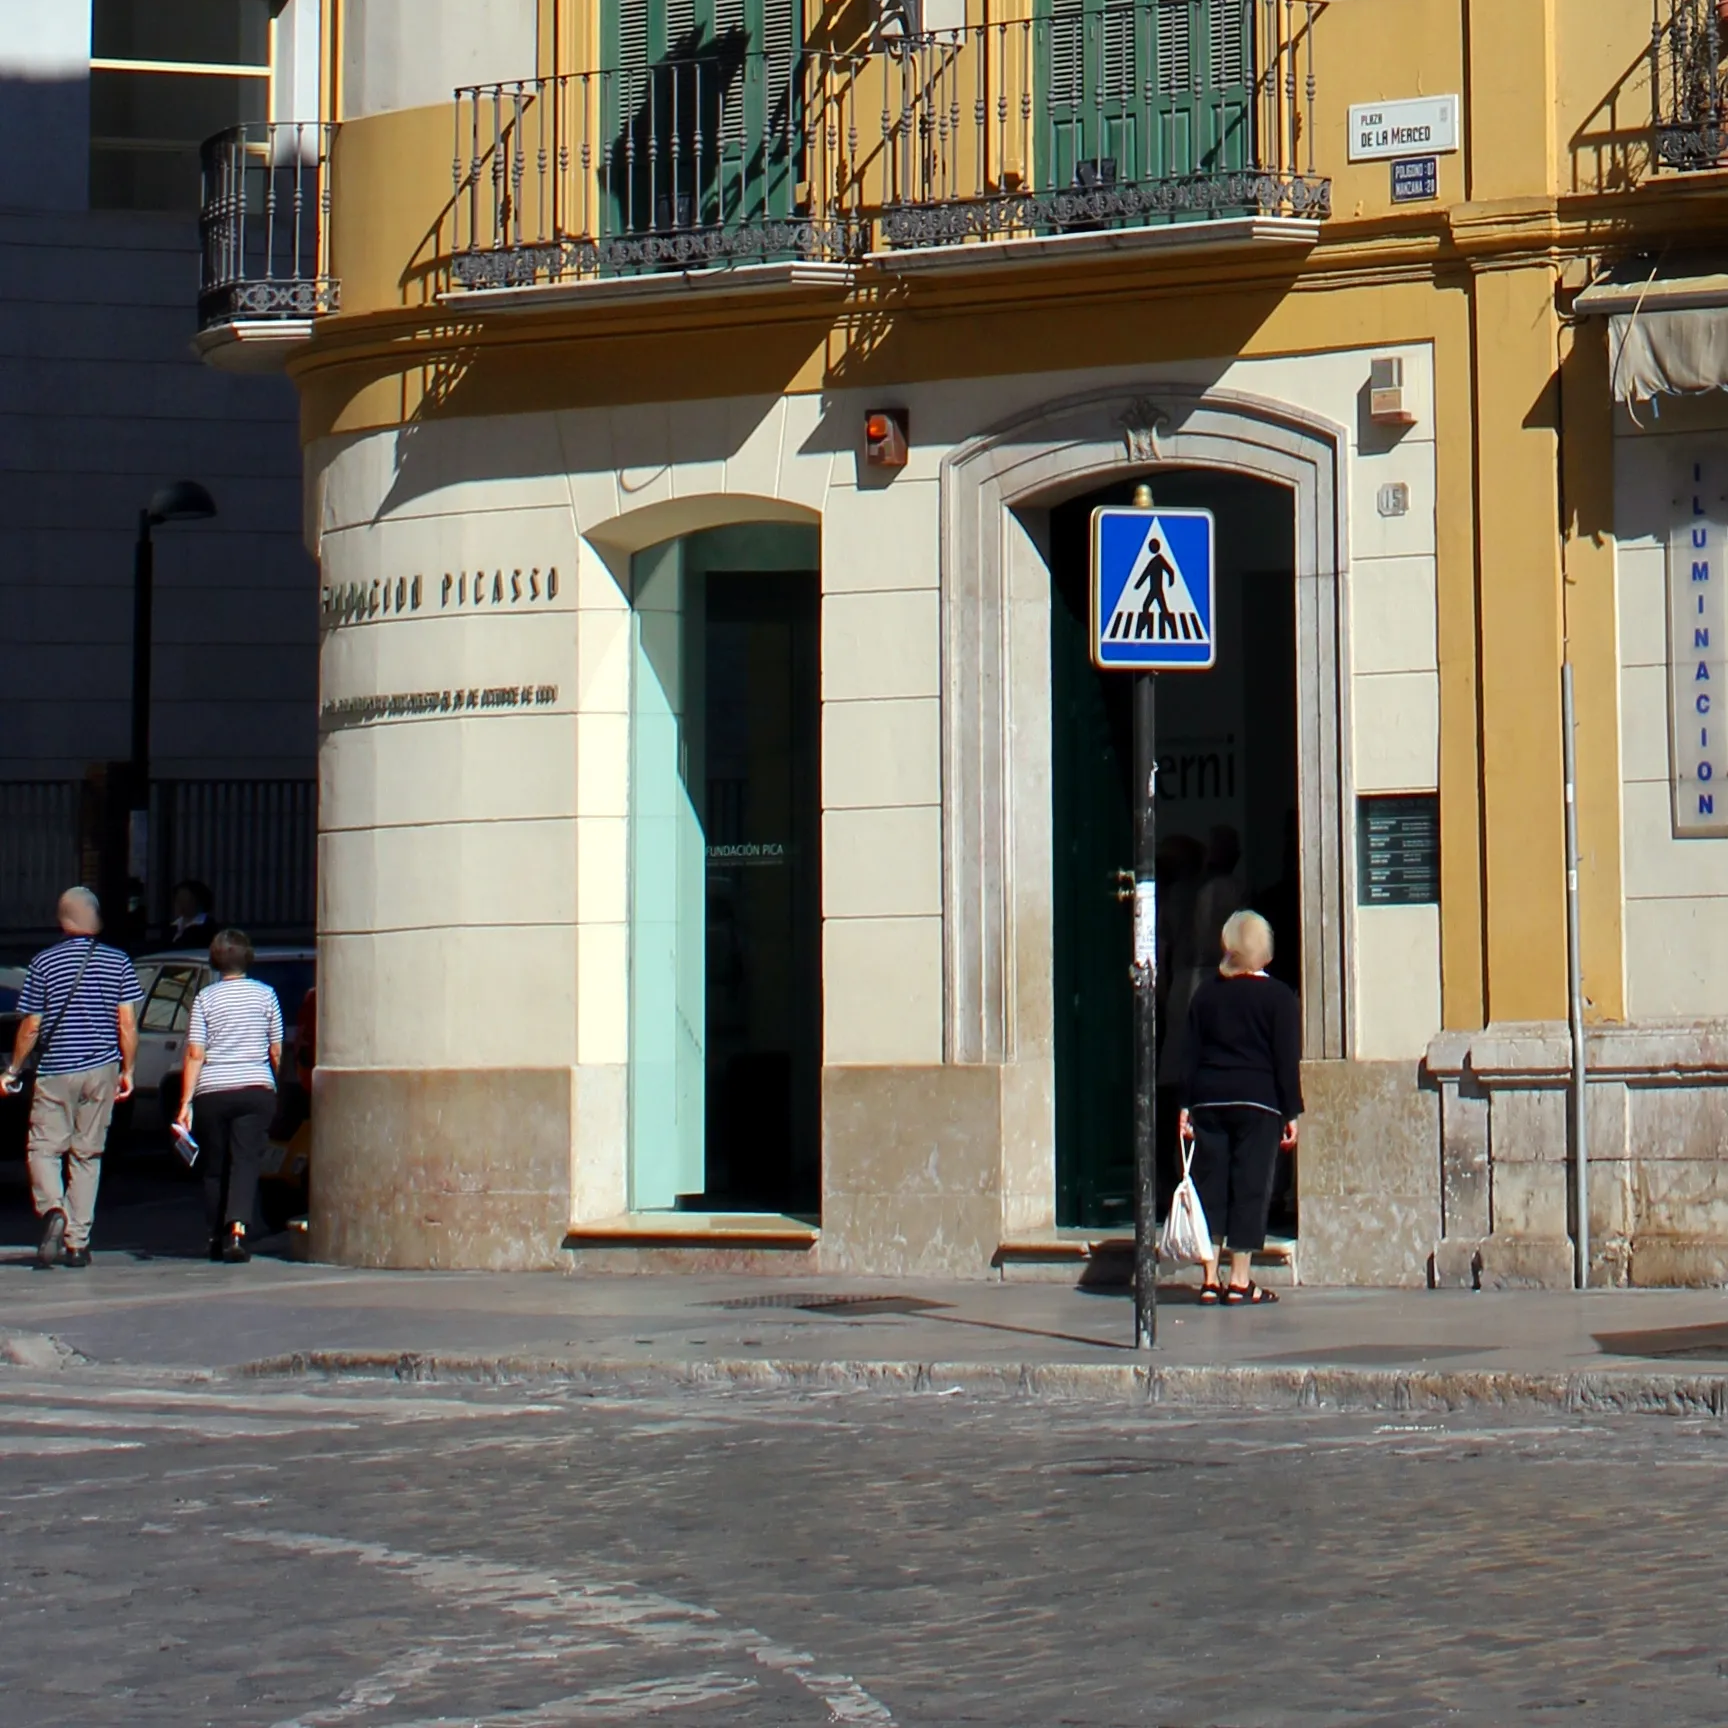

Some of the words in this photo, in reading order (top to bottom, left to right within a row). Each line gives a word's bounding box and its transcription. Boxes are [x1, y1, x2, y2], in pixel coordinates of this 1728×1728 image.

[1361, 113, 1383, 126] PLAZA
[1361, 132, 1373, 148] DE
[1376, 130, 1388, 146] LA
[1391, 126, 1431, 145] MERCED
[1385, 488, 1402, 509] 15
[442, 566, 559, 608] PICASSO
[1691, 463, 1714, 815] ILUMINACION
